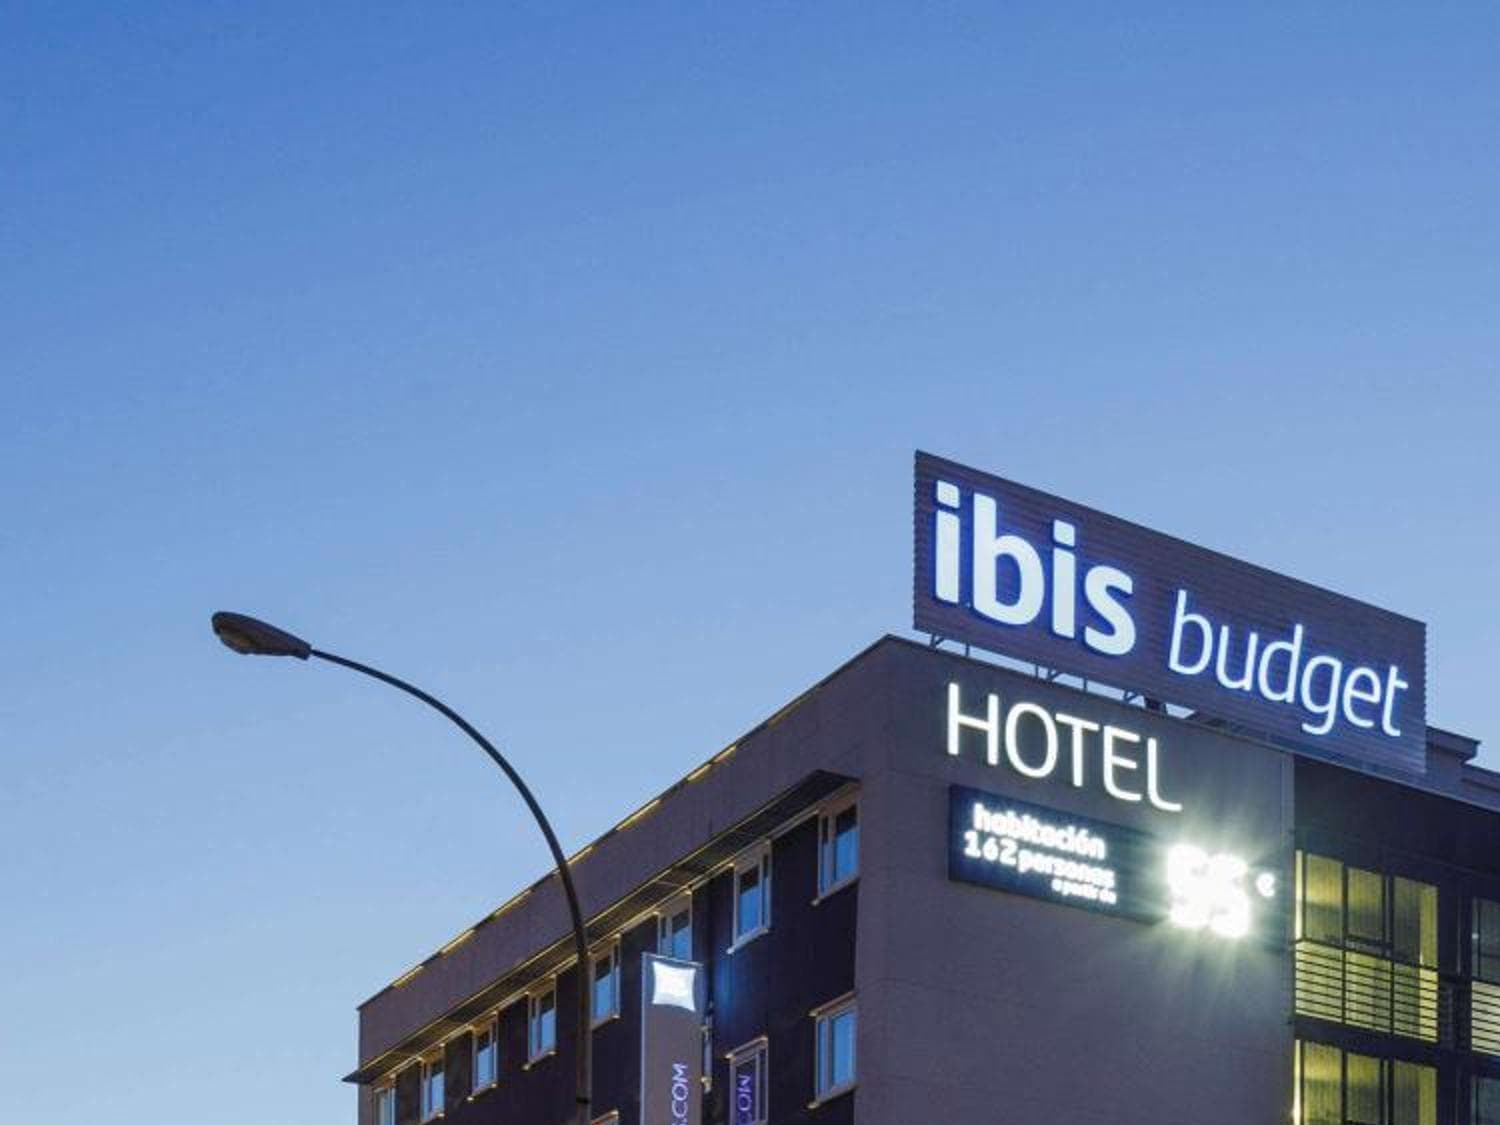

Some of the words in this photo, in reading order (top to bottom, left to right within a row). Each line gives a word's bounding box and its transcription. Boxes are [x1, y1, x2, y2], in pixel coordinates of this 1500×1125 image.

[935, 480, 1136, 656] ibis
[1168, 589, 1409, 738] budget
[946, 682, 1183, 813] HOTEL
[973, 802, 1106, 860] habitación
[1017, 849, 1115, 889] personas
